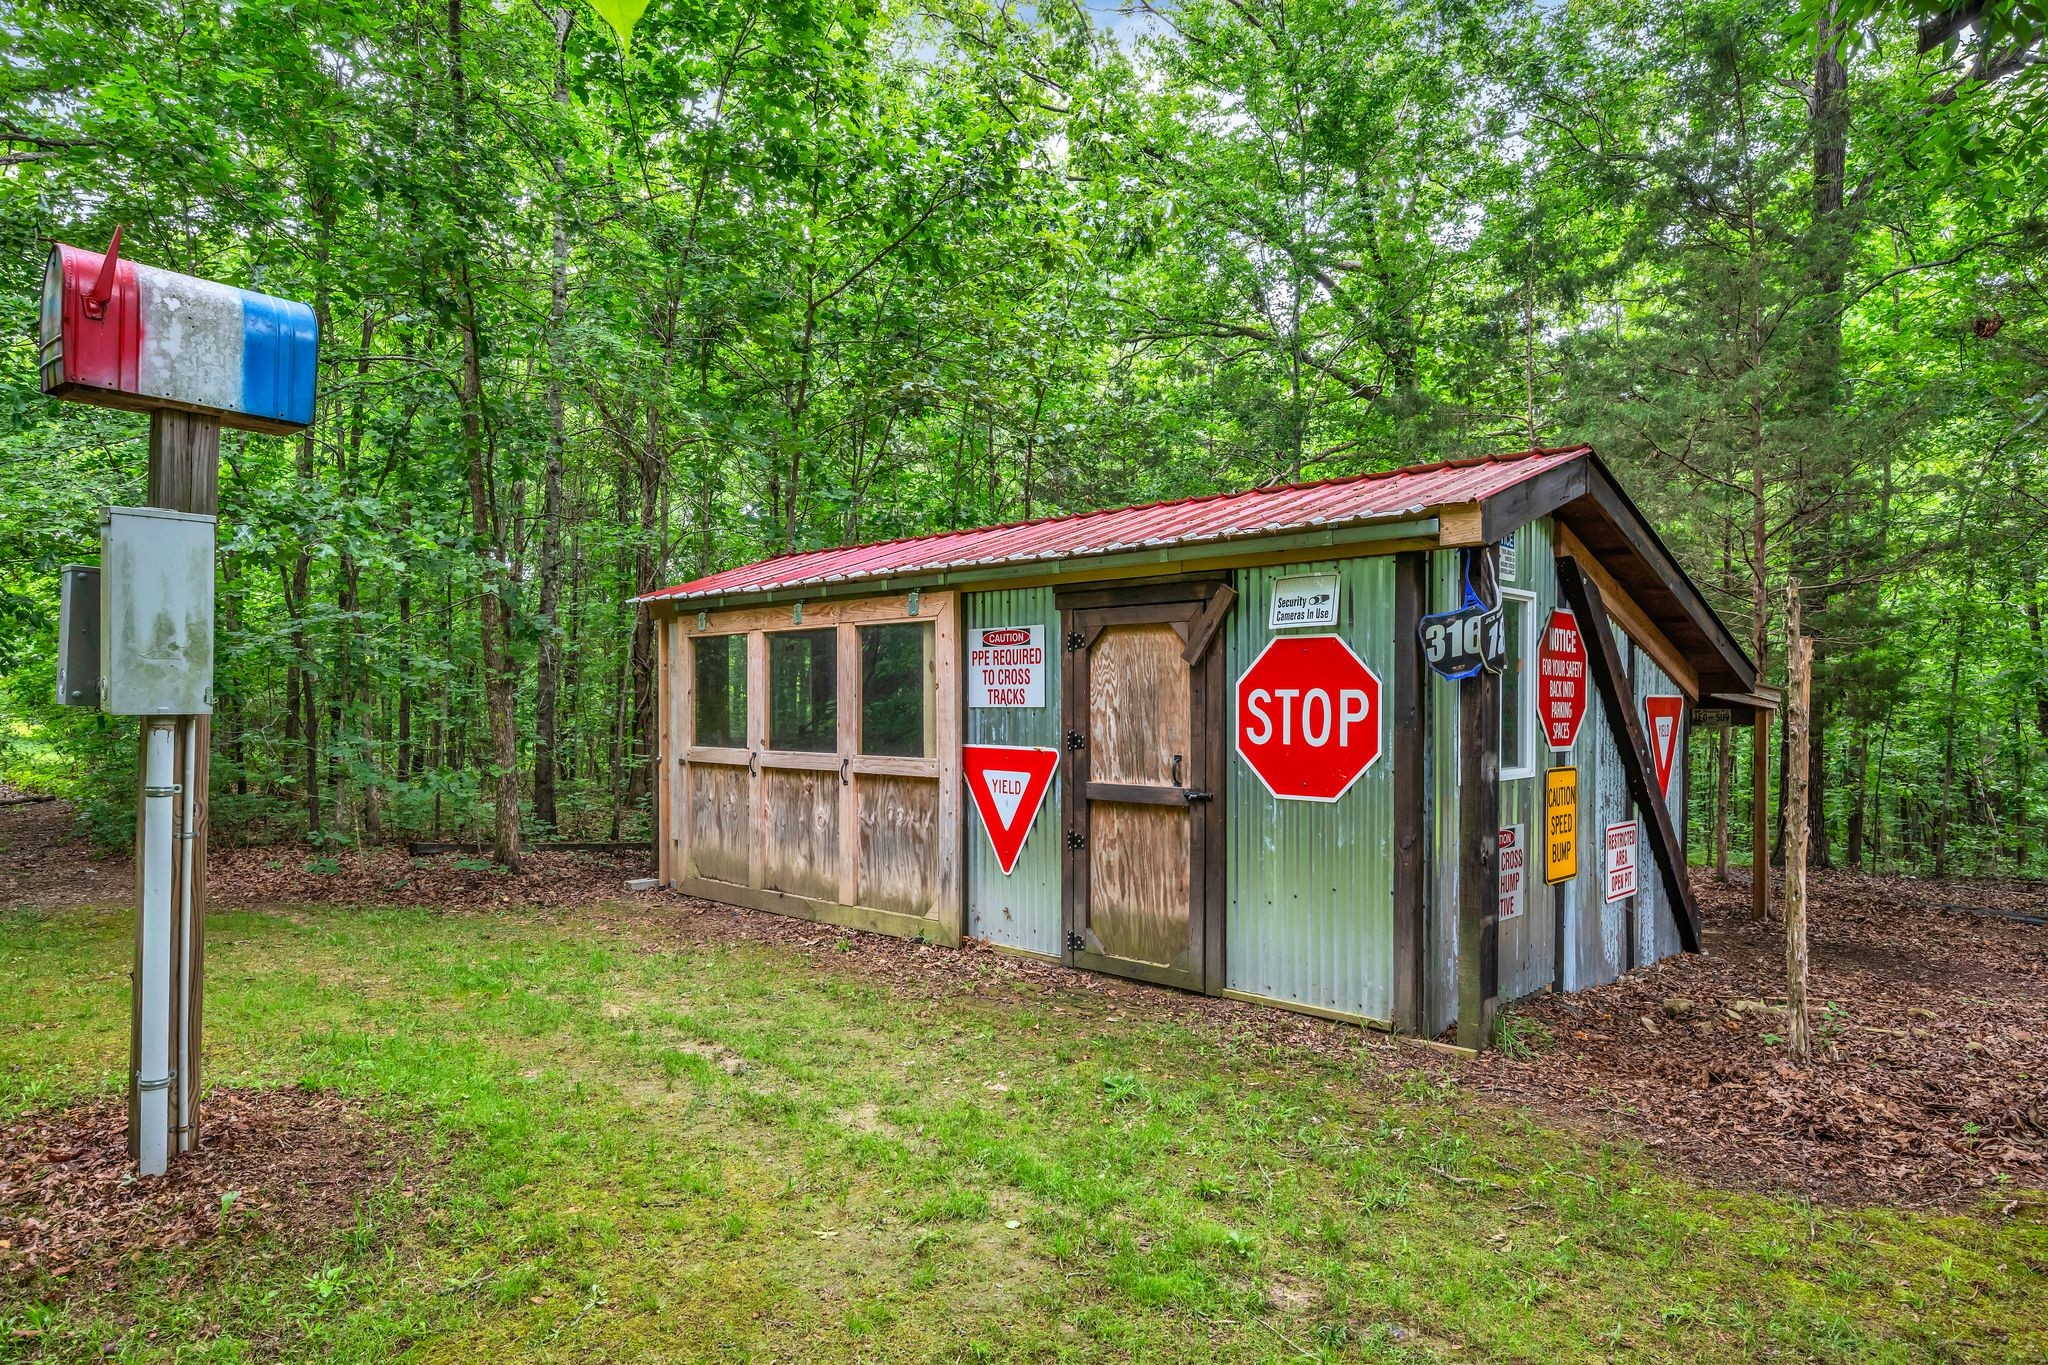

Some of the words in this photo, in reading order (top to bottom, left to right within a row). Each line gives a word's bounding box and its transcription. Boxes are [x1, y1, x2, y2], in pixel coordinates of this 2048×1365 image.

[1278, 596, 1307, 608] Security
[1276, 610, 1305, 621] Cameras
[1307, 608, 1314, 619] In
[1316, 608, 1329, 619] Use
[989, 632, 1024, 643] CAUTION
[1549, 627, 1576, 653] NOTICE
[972, 650, 990, 666] PPE
[993, 647, 1042, 666] REQUIRED
[982, 669, 995, 685] TO
[998, 668, 1031, 685] CROSS
[1542, 658, 1552, 676] FOR
[1552, 659, 1566, 677] YOUR
[1566, 661, 1583, 678] SAFETY
[987, 688, 1025, 705] TRACKS
[1549, 680, 1562, 697] BACK
[1562, 681, 1575, 698] INTO
[1246, 687, 1369, 747] STOP
[1551, 702, 1572, 718] PARKING
[1552, 722, 1570, 739] SPACES
[1659, 724, 1669, 737] YIELD
[992, 779, 1021, 794] YIELD
[1548, 786, 1575, 808] CAUTION
[1551, 813, 1572, 836] SPEED
[1499, 832, 1511, 844] TION
[1608, 830, 1635, 850] RESTRICTED
[1501, 849, 1523, 871] CROSS
[1552, 841, 1571, 863] BUMP
[1616, 849, 1628, 866] AREA
[1500, 872, 1520, 894] HUMP
[1611, 874, 1624, 892] OPEN
[1624, 871, 1632, 887] PIT
[1499, 896, 1514, 917] TIVE
